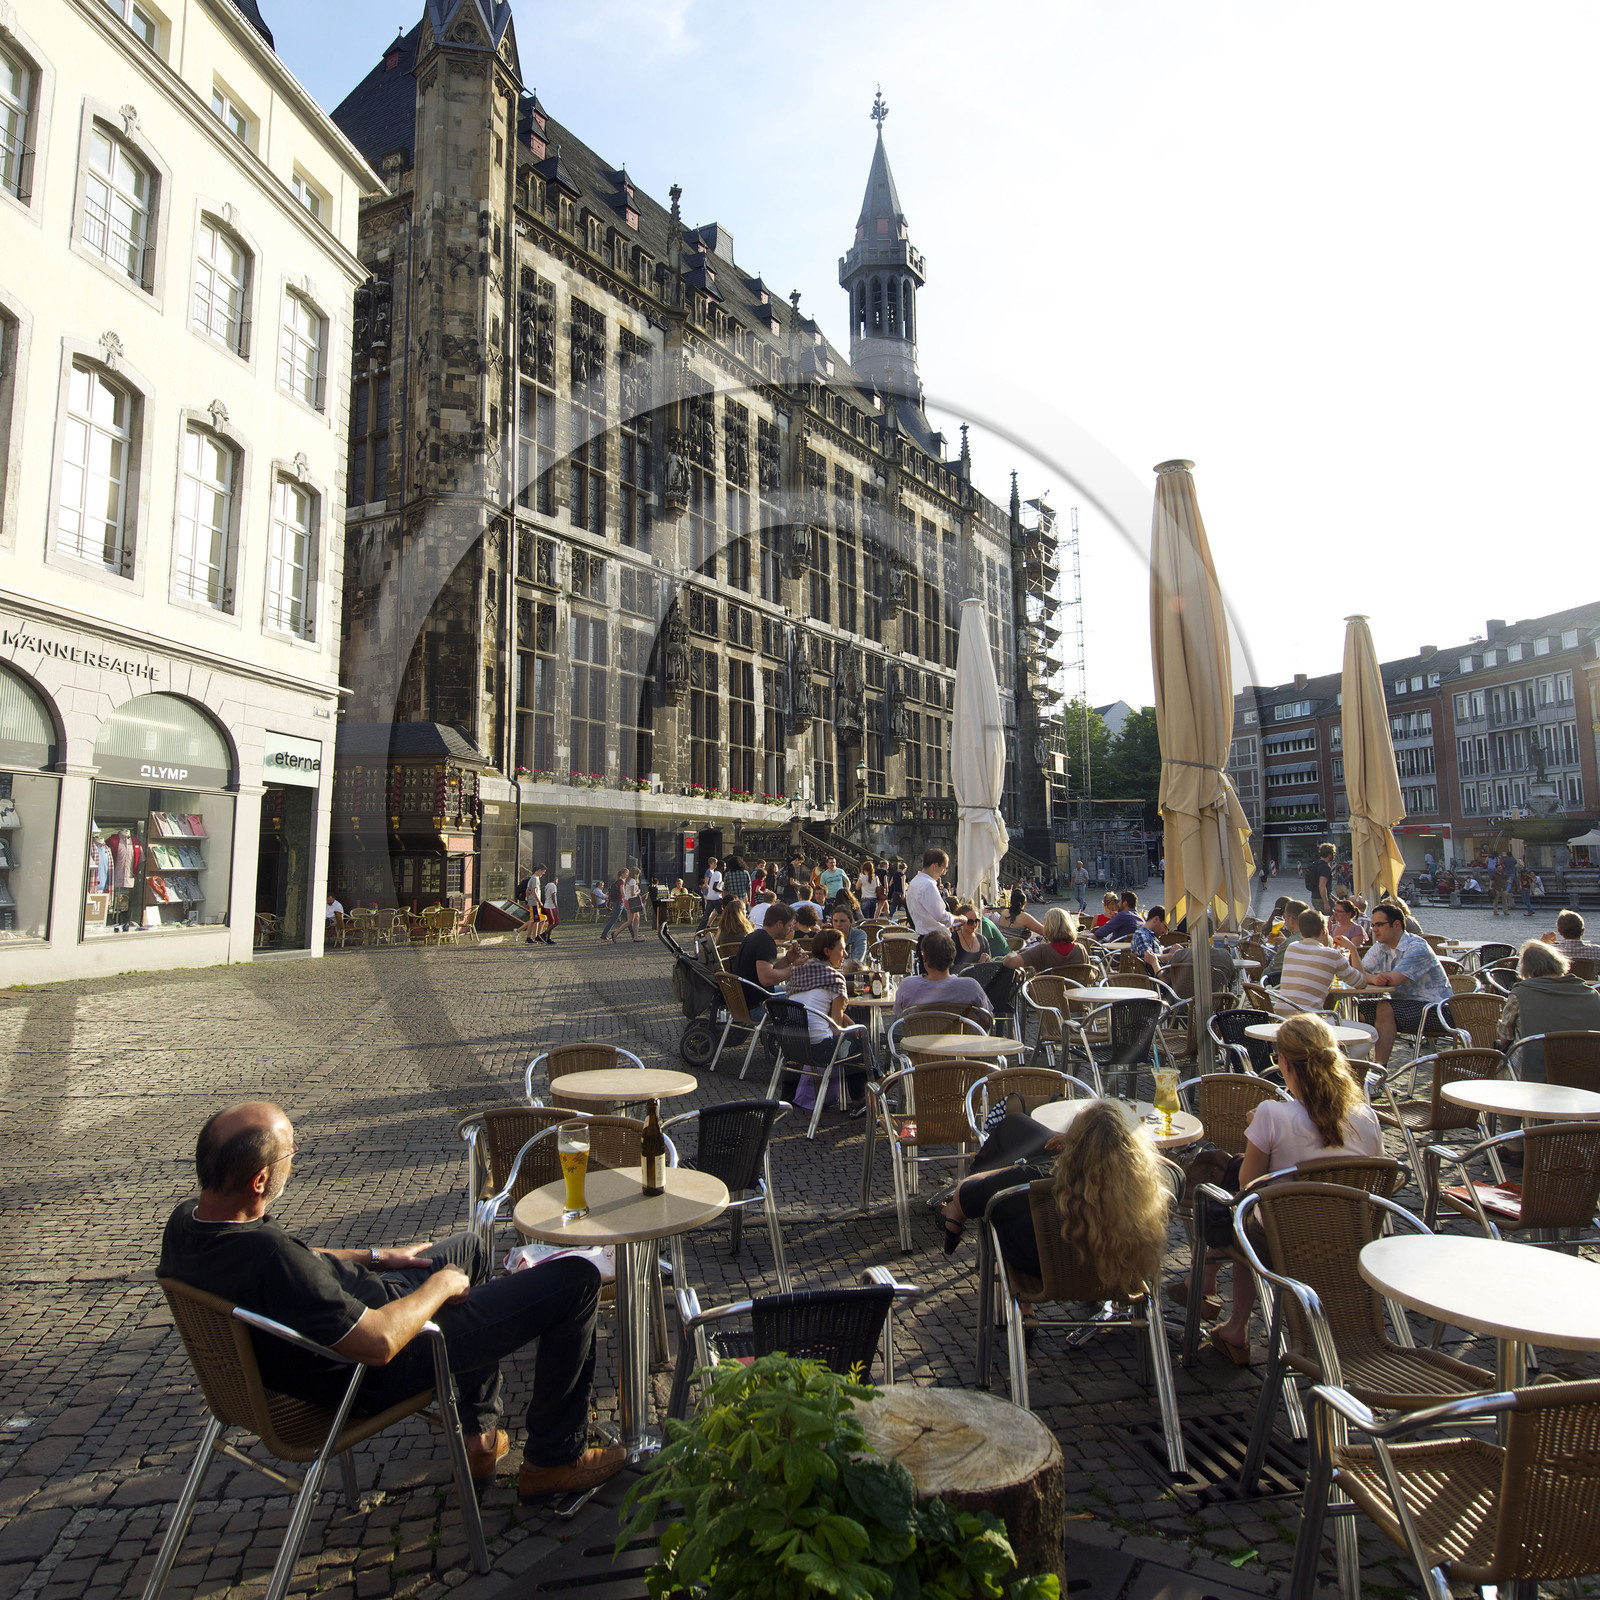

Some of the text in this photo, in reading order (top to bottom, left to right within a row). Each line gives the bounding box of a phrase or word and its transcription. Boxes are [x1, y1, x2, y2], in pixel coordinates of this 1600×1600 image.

[2, 630, 160, 682] MÄNNERSACHE
[275, 752, 320, 771] eterna
[140, 764, 188, 780] OLYMP
